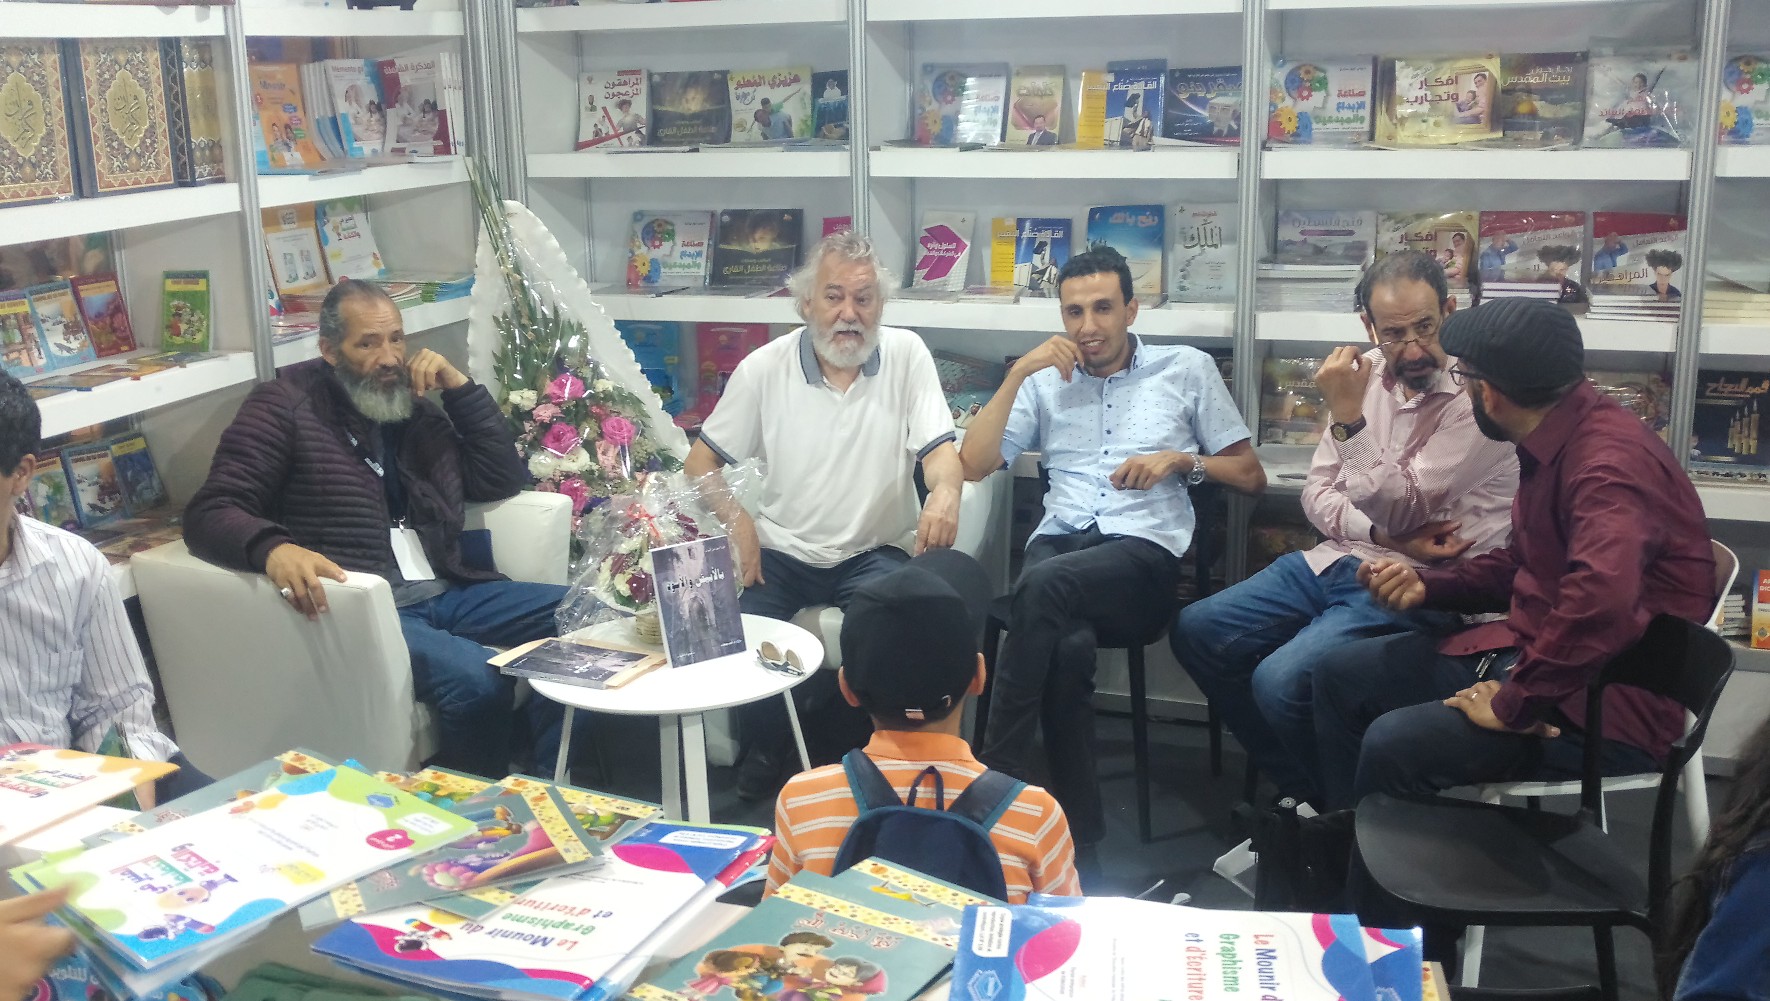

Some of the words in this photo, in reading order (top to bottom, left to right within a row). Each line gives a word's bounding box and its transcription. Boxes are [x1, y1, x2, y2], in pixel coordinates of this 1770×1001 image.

[604, 77, 642, 89] المراهقون
[1500, 73, 1548, 87] المقدس
[1548, 74, 1571, 86] بيت
[604, 88, 642, 99] المزعجون
[595, 910, 614, 921] et
[461, 921, 484, 936] du
[501, 912, 596, 936] Graphisme
[486, 928, 556, 948] Mounir
[1184, 932, 1204, 943] et
[1253, 933, 1275, 946] Le
[559, 938, 579, 951] Le
[1215, 933, 1243, 993] Graphisme
[1255, 948, 1281, 992] Mounir
